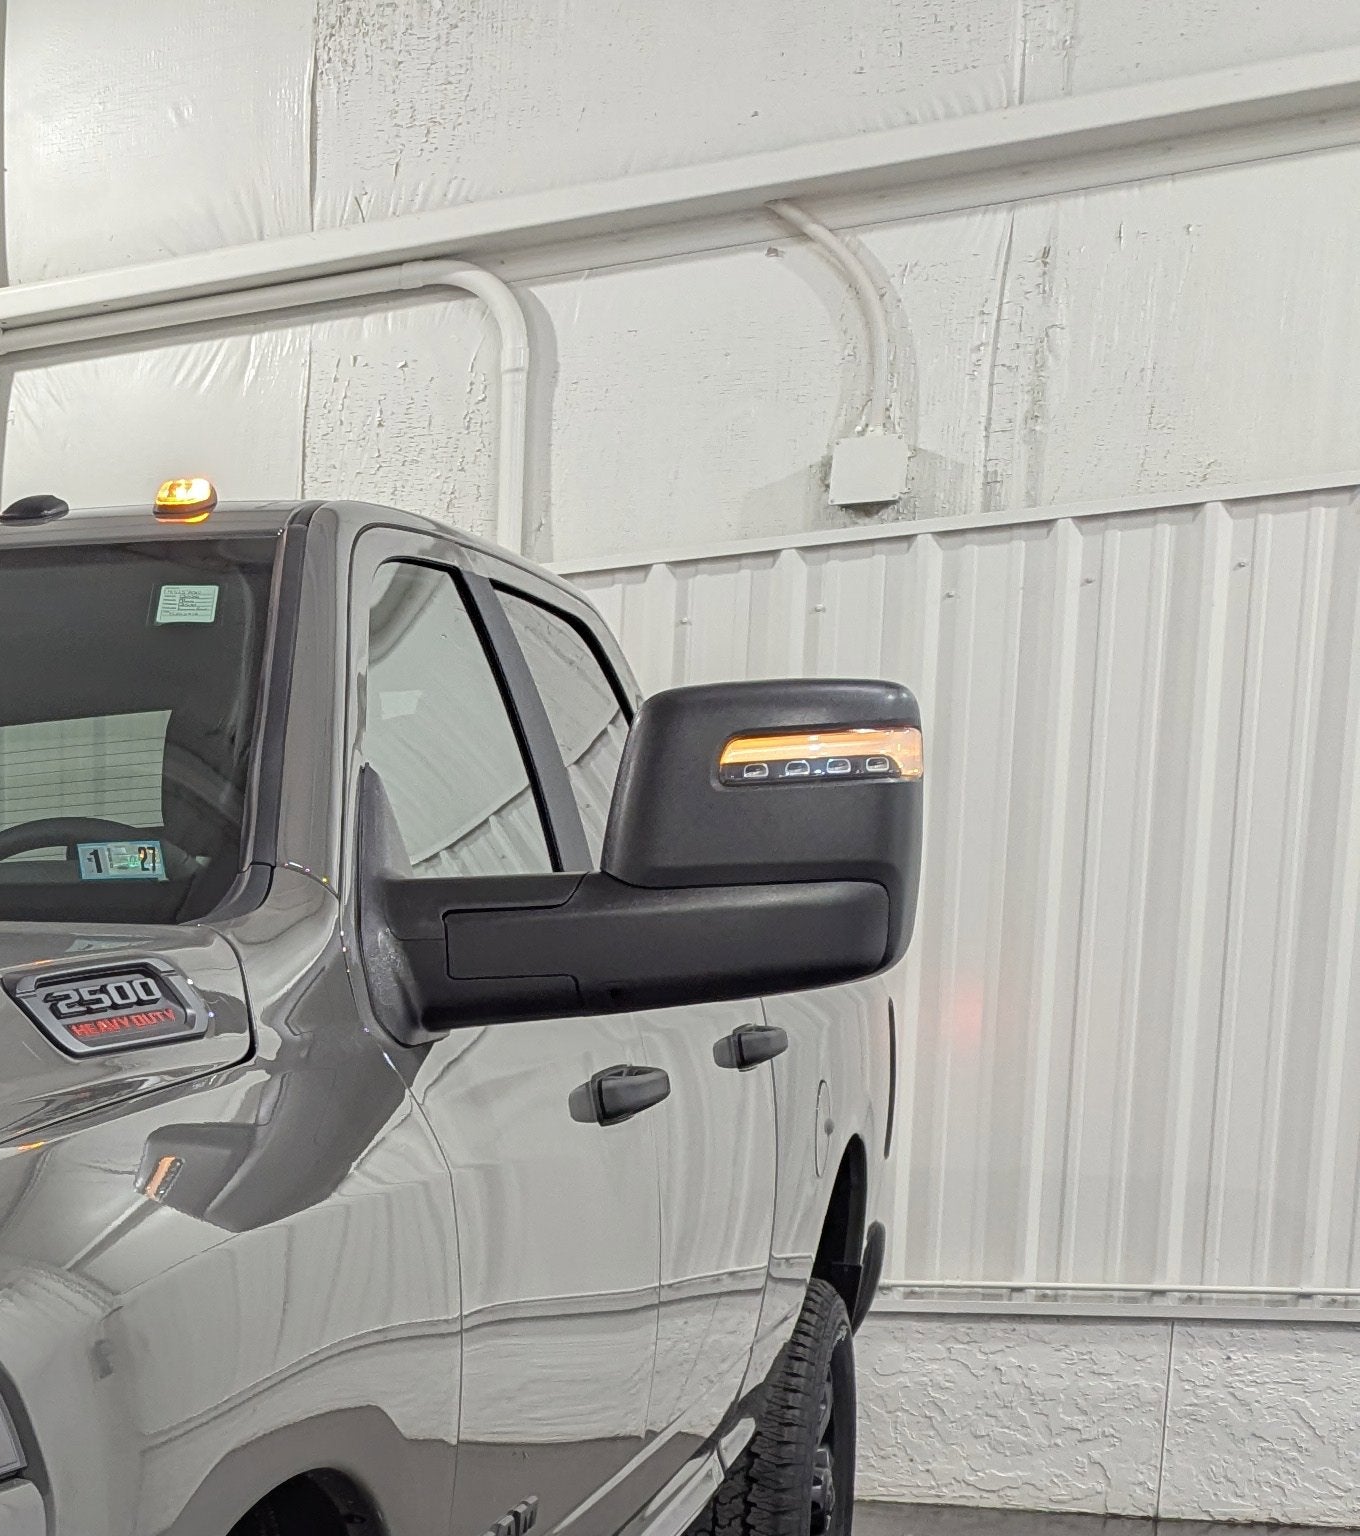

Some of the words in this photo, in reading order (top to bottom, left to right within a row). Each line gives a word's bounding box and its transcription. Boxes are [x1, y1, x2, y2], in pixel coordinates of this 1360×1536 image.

[48, 977, 163, 1019] 2500
[70, 1017, 130, 1037] HEAVY
[134, 1008, 177, 1028] DUTY
